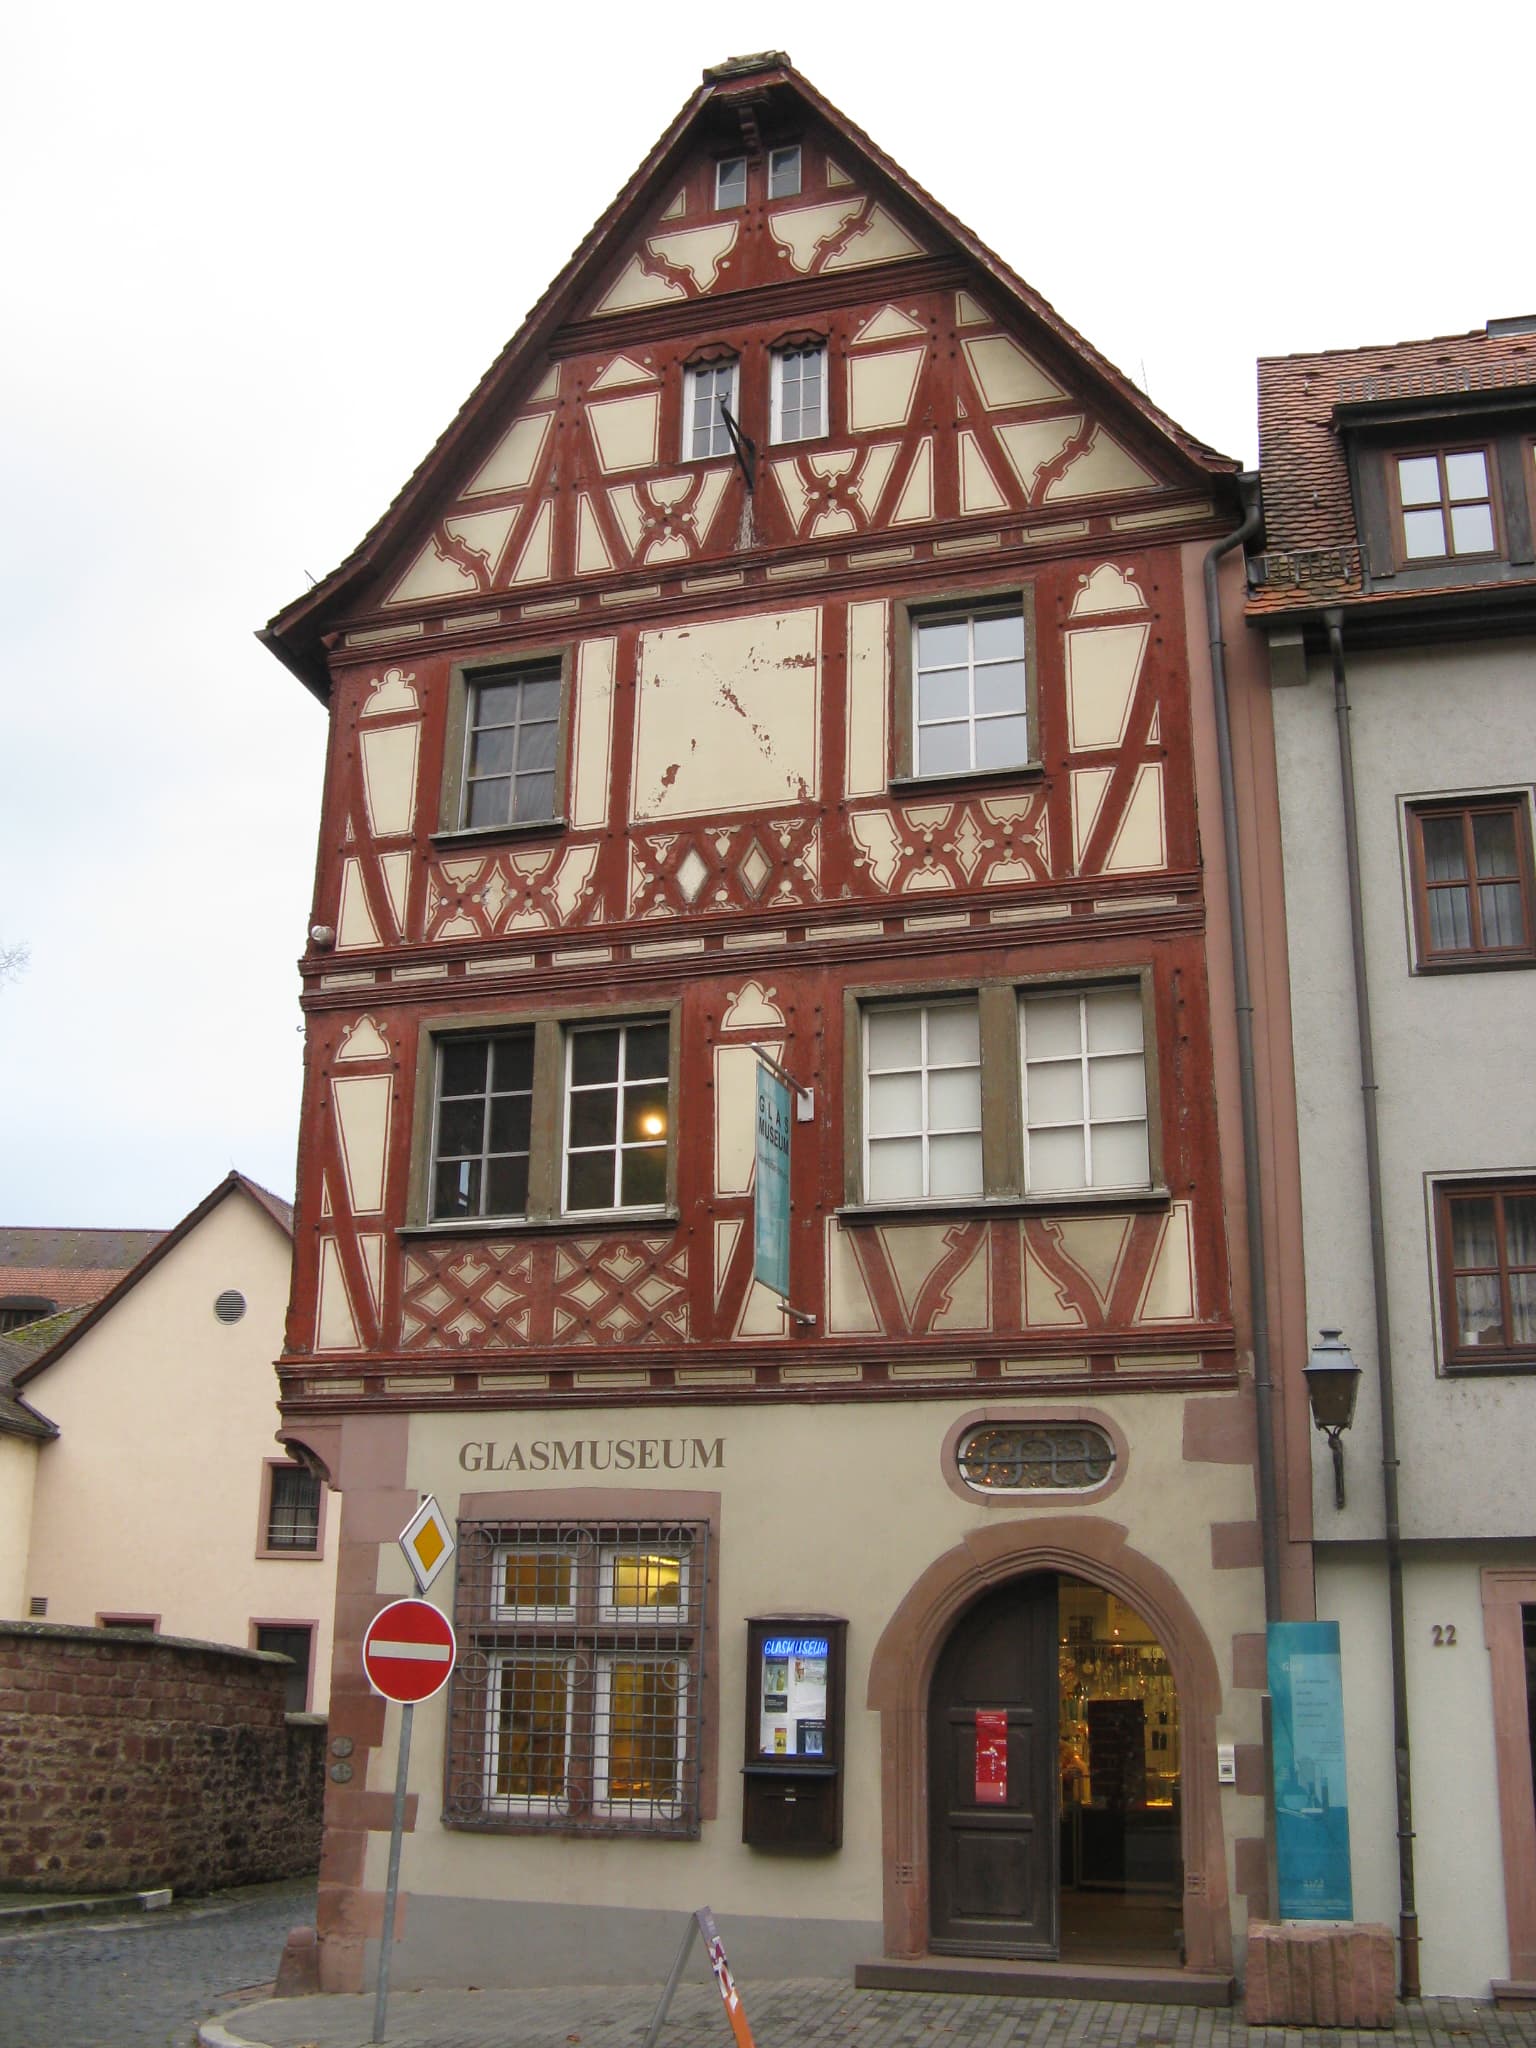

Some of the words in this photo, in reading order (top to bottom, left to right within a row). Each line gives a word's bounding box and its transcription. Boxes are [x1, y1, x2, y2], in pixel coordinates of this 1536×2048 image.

[759, 1116, 789, 1156] MUSEUM
[458, 1438, 727, 1472] GLASMUSEUM
[764, 1640, 828, 1655] GLASMUSEUM
[1431, 1624, 1457, 1647] 22
